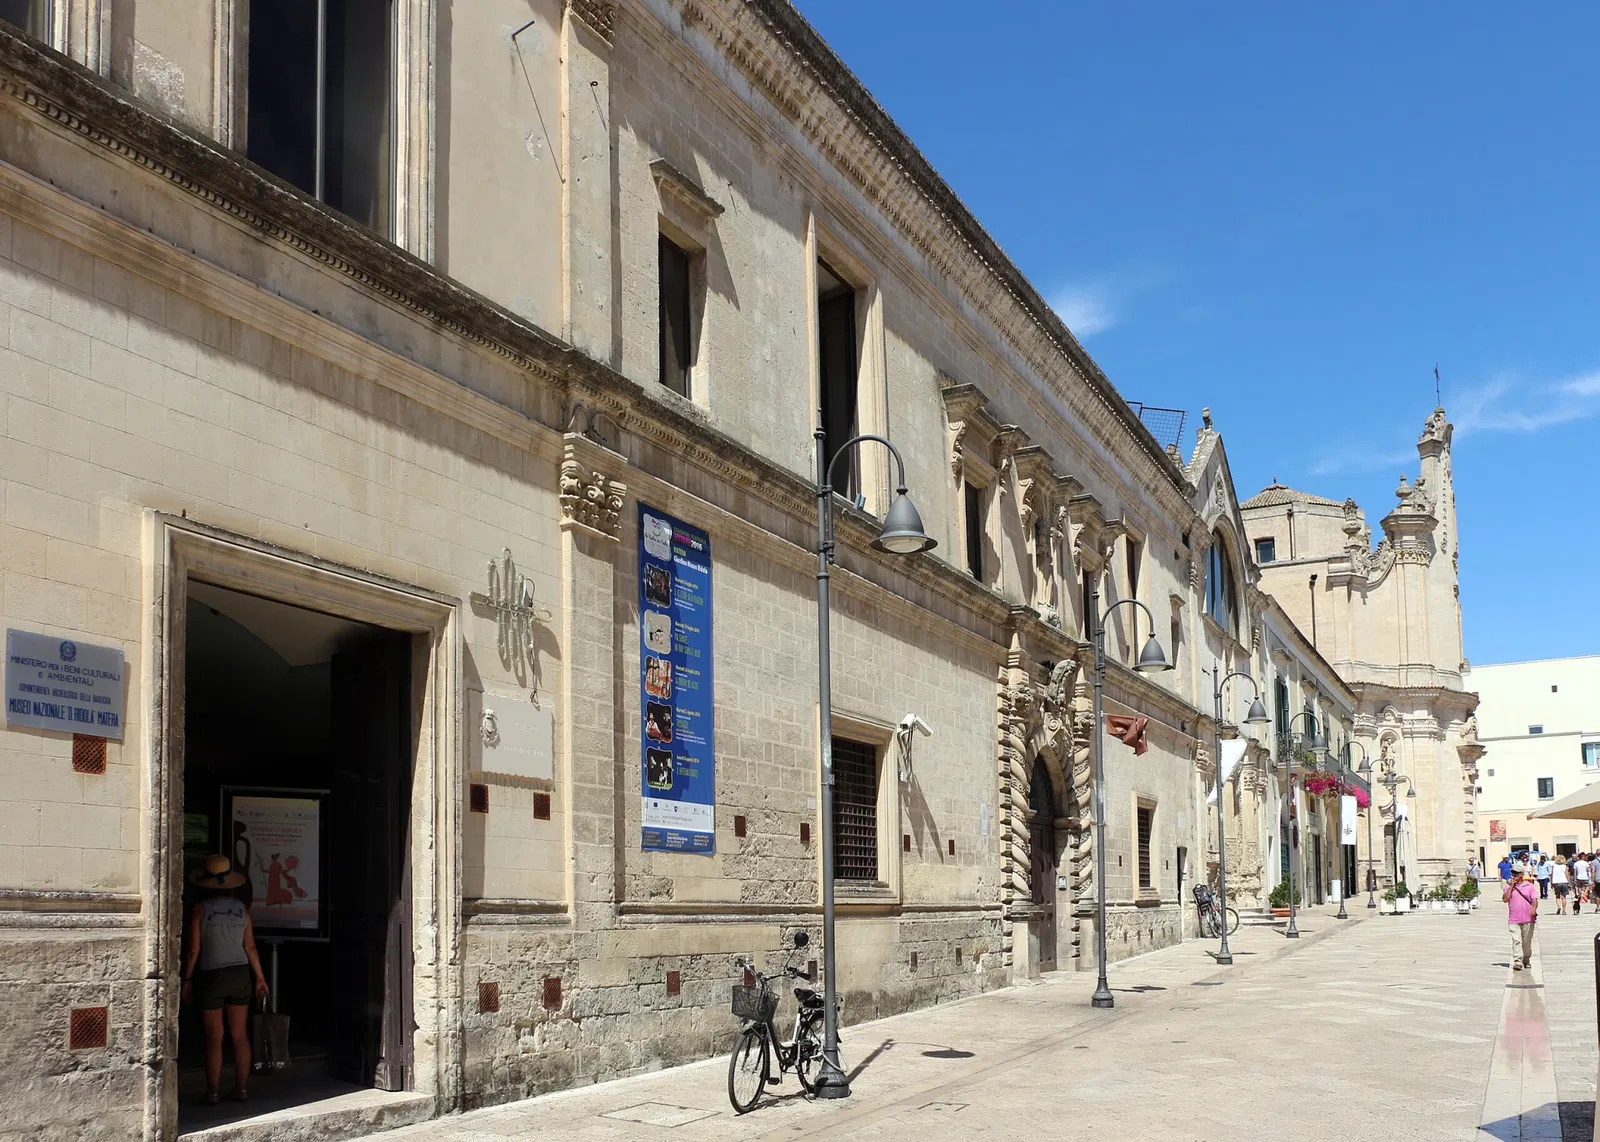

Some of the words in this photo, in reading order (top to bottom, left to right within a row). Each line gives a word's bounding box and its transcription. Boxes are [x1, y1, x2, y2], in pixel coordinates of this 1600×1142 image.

[11, 656, 47, 668] MINISTERO
[48, 663, 59, 672] PER
[64, 664, 81, 674] BENI
[82, 668, 120, 681] CULTURALI
[48, 672, 94, 686] AMBIENTALI
[9, 698, 31, 714] MUSEO
[33, 701, 65, 719] NAZIONALE
[98, 710, 119, 727] MATERA
